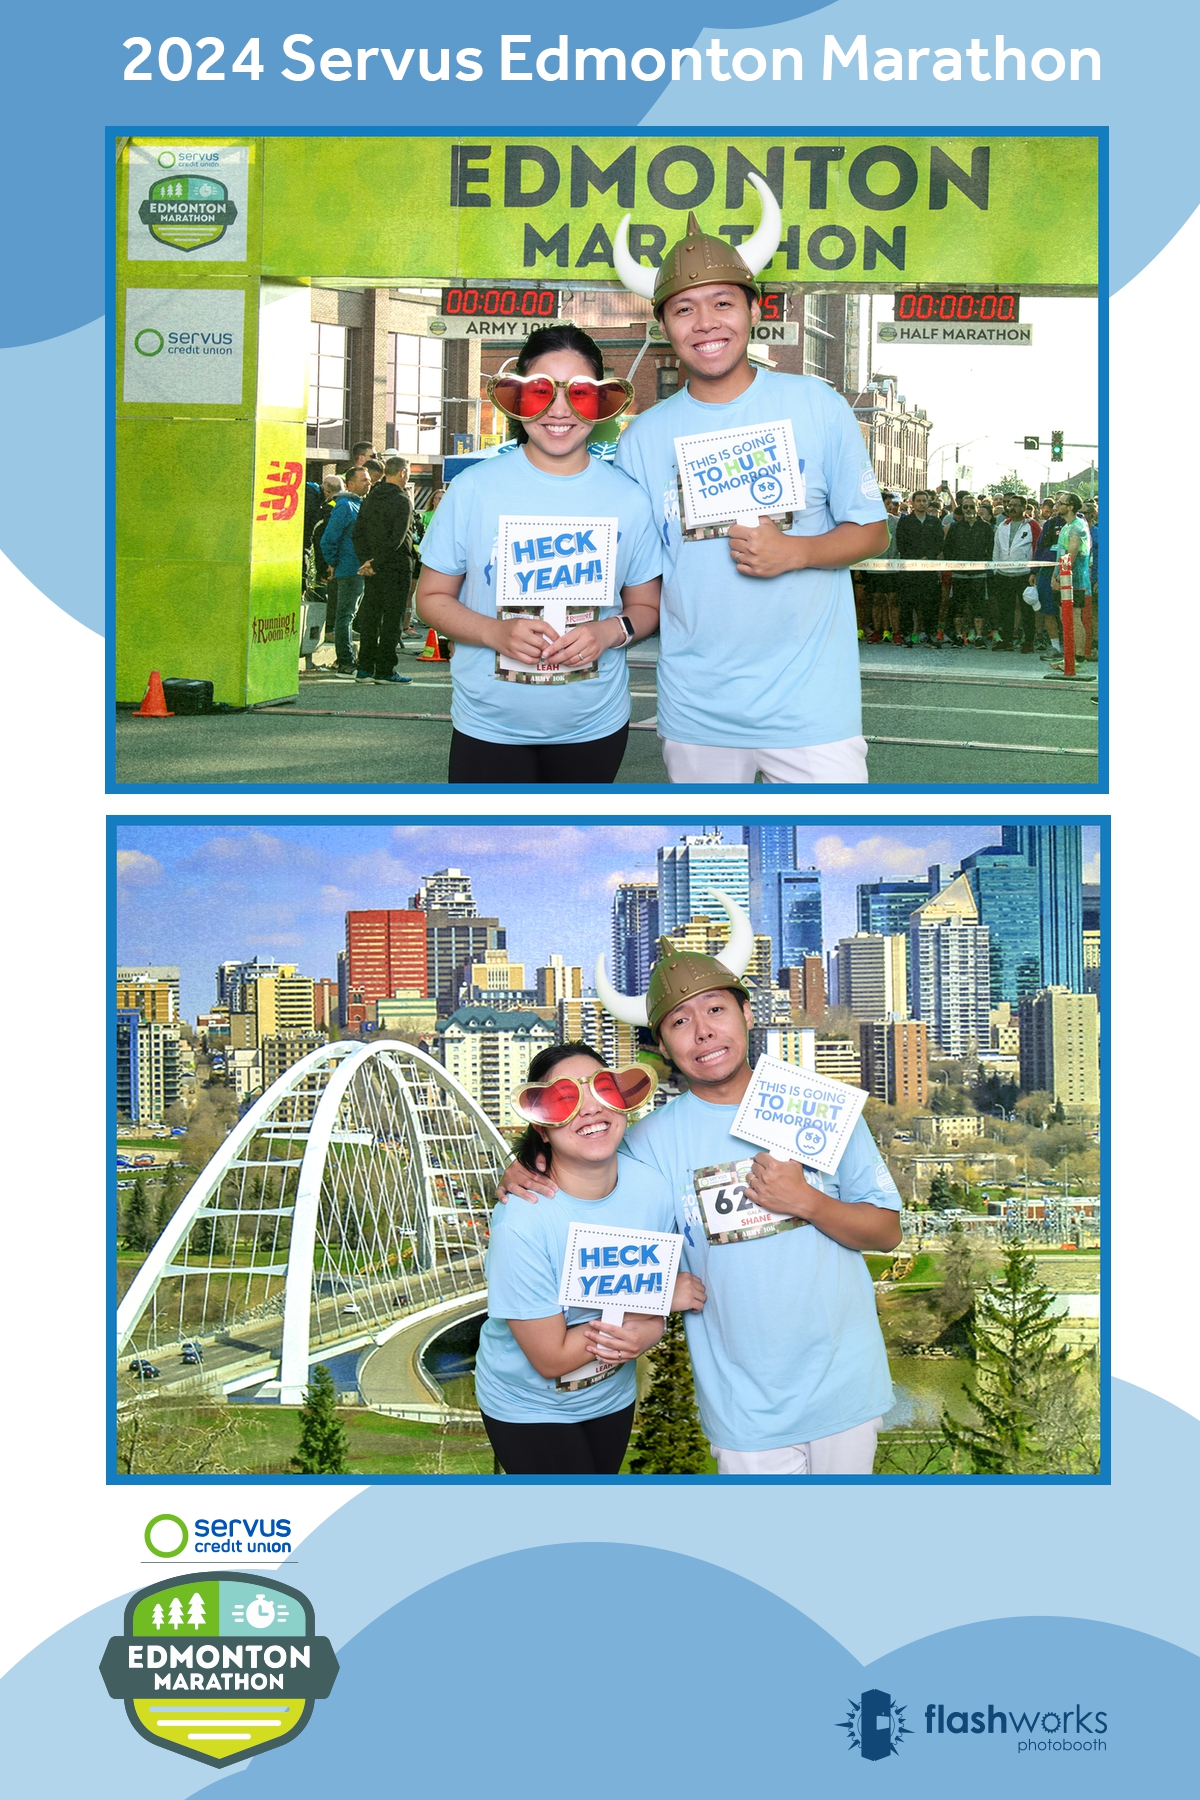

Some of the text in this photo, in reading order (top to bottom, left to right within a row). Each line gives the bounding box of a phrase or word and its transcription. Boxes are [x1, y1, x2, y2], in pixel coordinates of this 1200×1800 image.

[178, 152, 219, 161] servus
[449, 144, 990, 212] EDMONTON
[149, 202, 227, 214] EDMONTON
[160, 214, 216, 222] MARATHON
[523, 221, 907, 272] MARTHON
[168, 331, 233, 345] servus
[466, 321, 518, 335] ARMY
[900, 328, 1031, 341] HALF MARATHON
[168, 345, 233, 355] credit union
[688, 433, 776, 472] THIS IS GOING
[694, 445, 778, 487] TO HURT
[698, 462, 787, 499] TOMORROW.
[511, 529, 598, 565] HECK
[514, 560, 603, 595] YEAH!
[258, 613, 290, 635] Running
[758, 1080, 846, 1104] THIS IS GOING
[758, 1092, 843, 1121] TO HURT
[754, 1108, 839, 1134] TOMORROW.
[715, 1185, 755, 1215] 62
[741, 1214, 772, 1226] SHANE
[742, 1228, 762, 1238] ARMY
[578, 1244, 660, 1270] HECK
[578, 1272, 663, 1297] YEAH!
